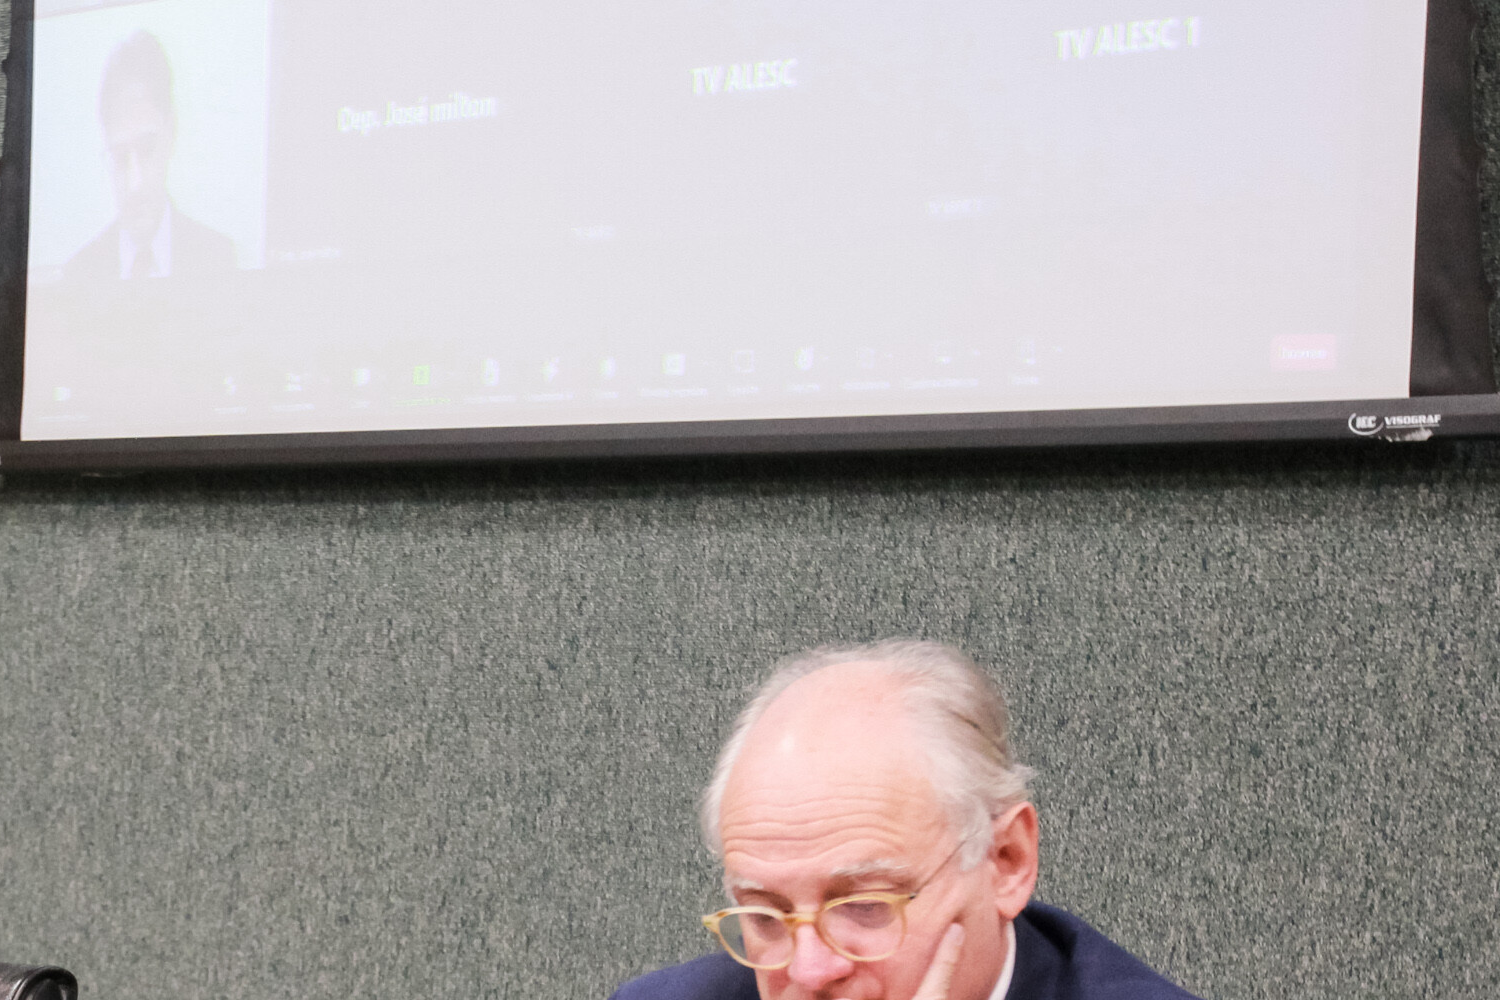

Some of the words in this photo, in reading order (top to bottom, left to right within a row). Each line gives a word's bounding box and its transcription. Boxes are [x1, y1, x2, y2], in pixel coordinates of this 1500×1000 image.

[1053, 28, 1088, 60] TV
[1091, 19, 1179, 58] ALESC
[1184, 16, 1202, 47] 1
[690, 66, 721, 95] TV
[723, 59, 798, 93] ALESC
[336, 106, 380, 136] Dep.
[383, 96, 428, 127] José
[429, 91, 496, 122] milton
[1384, 414, 1442, 426] VISOGRAF
